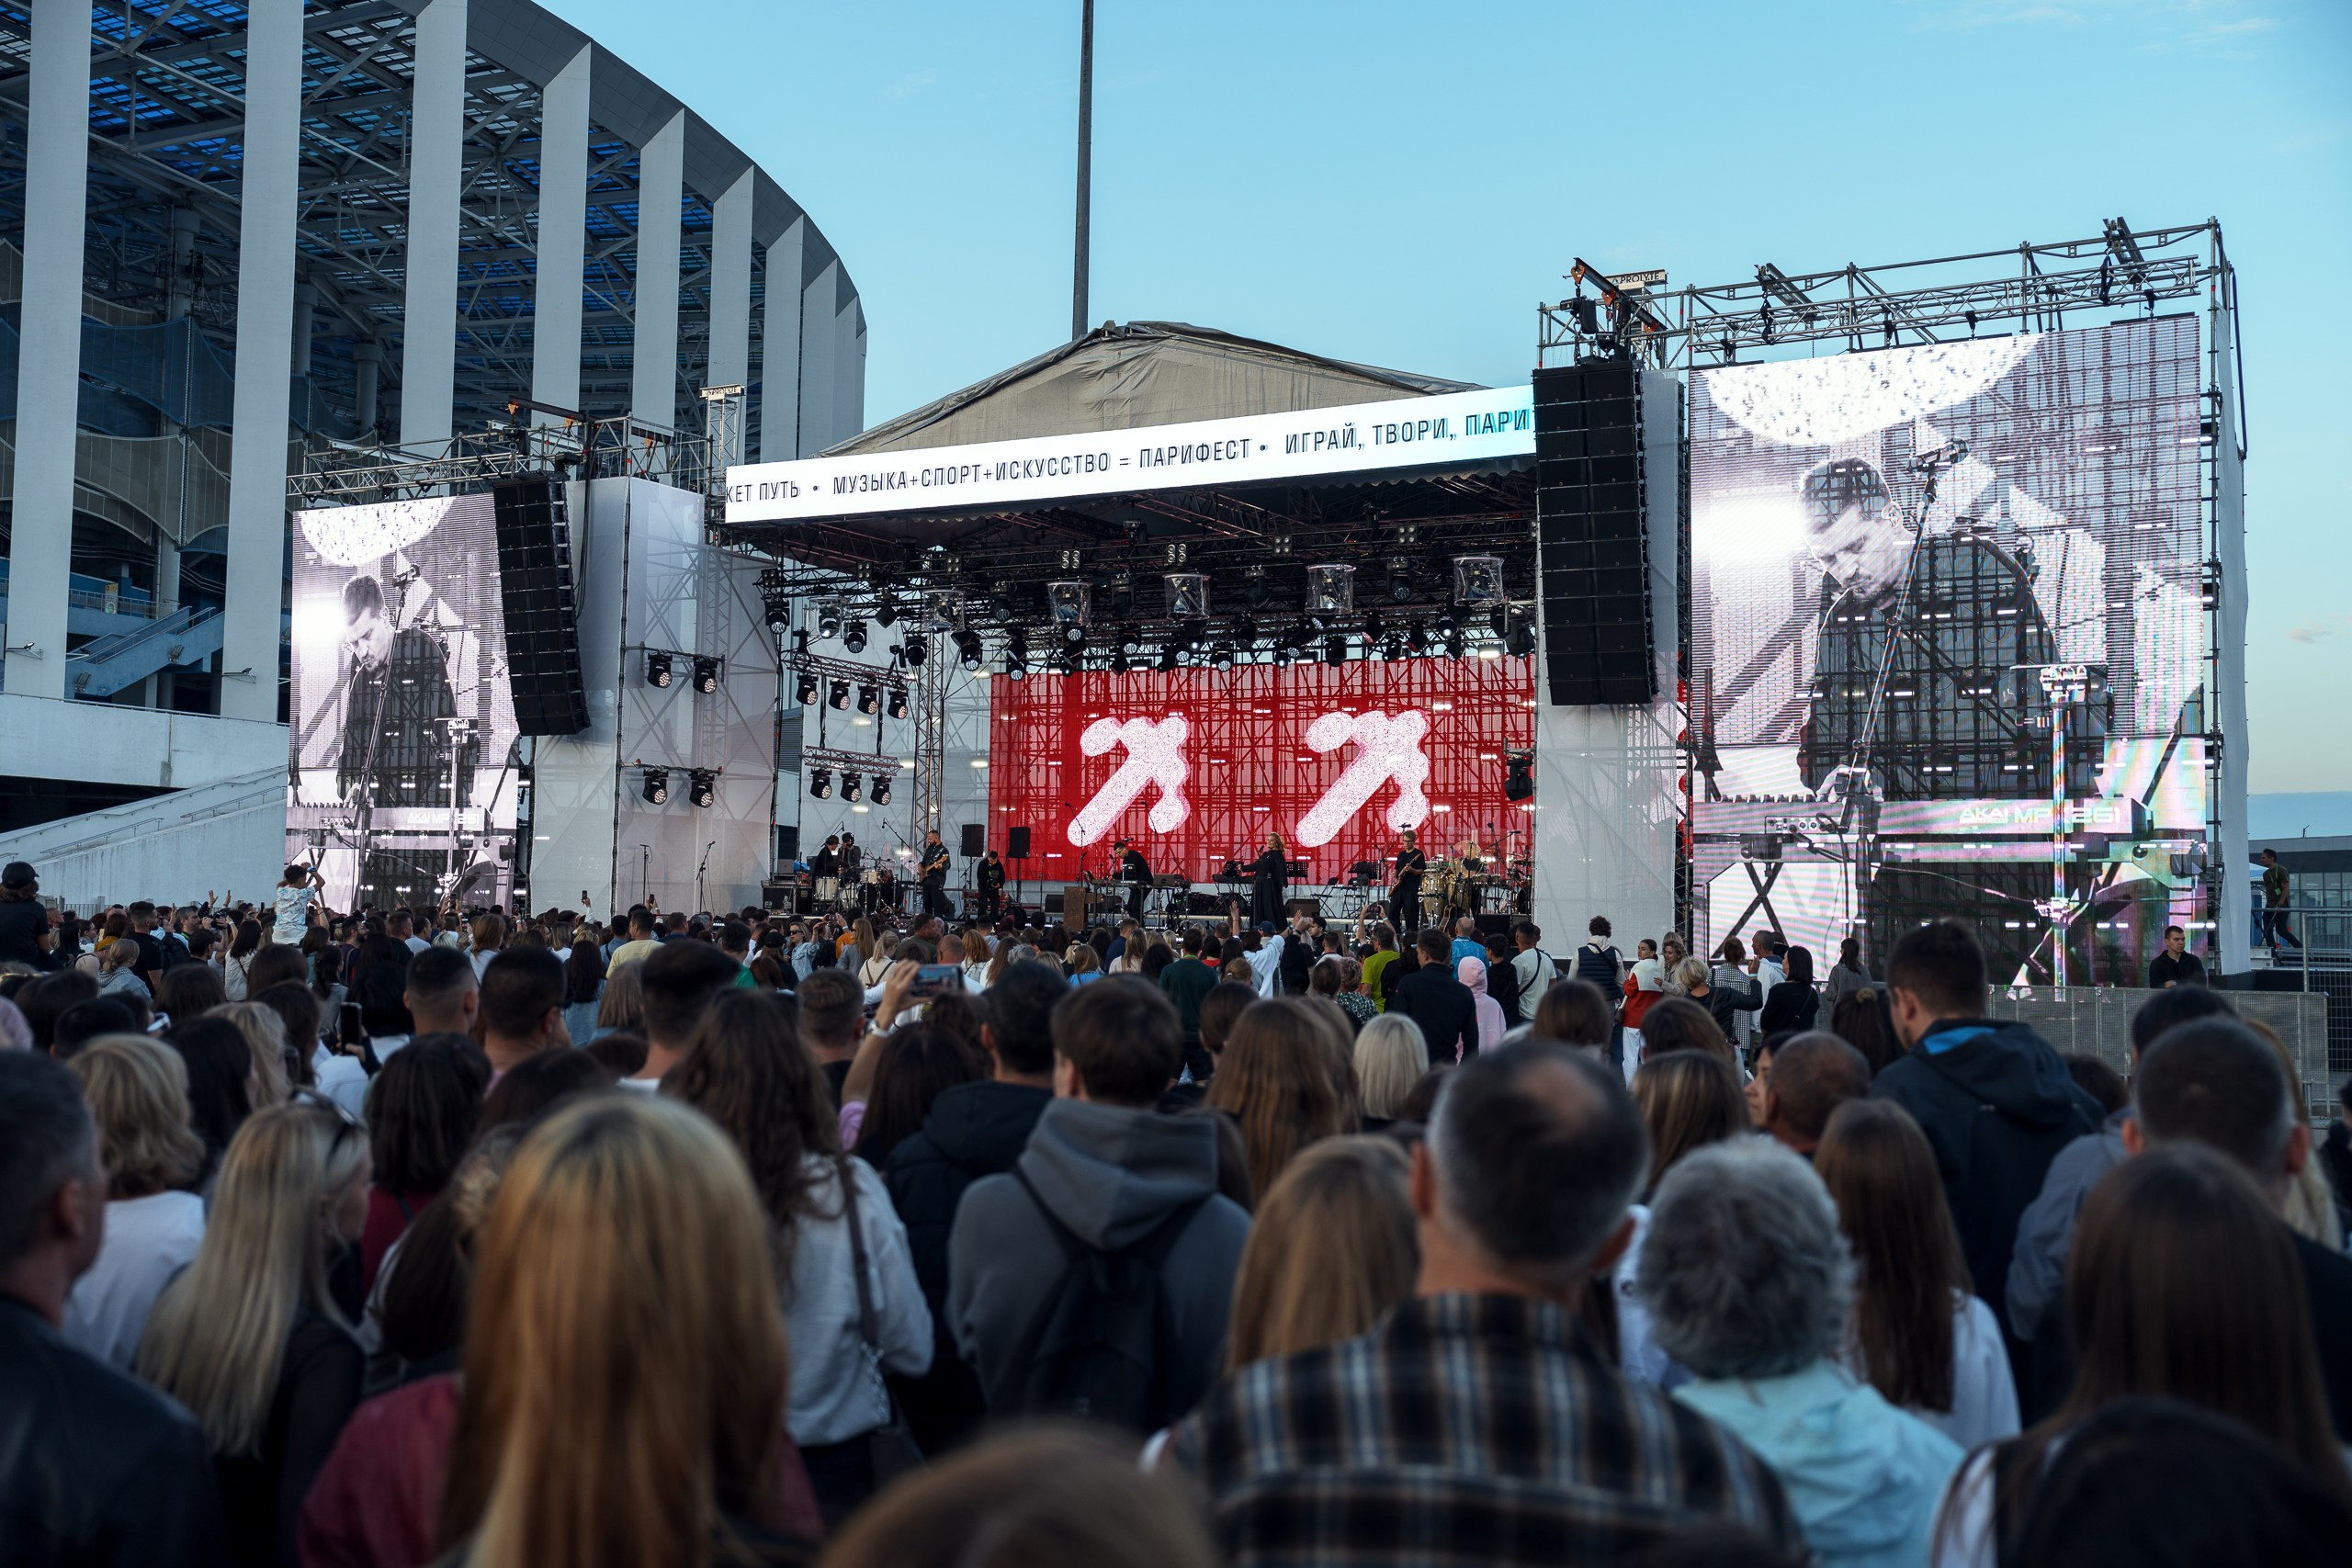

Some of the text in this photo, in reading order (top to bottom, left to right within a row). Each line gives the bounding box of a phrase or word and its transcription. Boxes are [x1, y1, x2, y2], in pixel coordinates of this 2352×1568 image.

[1621, 272, 1659, 283] PROLYTE
[759, 480, 800, 501] ПУТЬ
[833, 452, 1111, 494] МУЗЫКА+СПОРТ+ИСКУССТВО
[1139, 438, 1252, 468] ПАРИФЕСТ
[1285, 422, 1364, 454] ИГРАЙ,
[1373, 417, 1456, 445] ТВОРИ,
[1465, 409, 1530, 436] ПАРИ
[1960, 807, 2009, 818] AKAI
